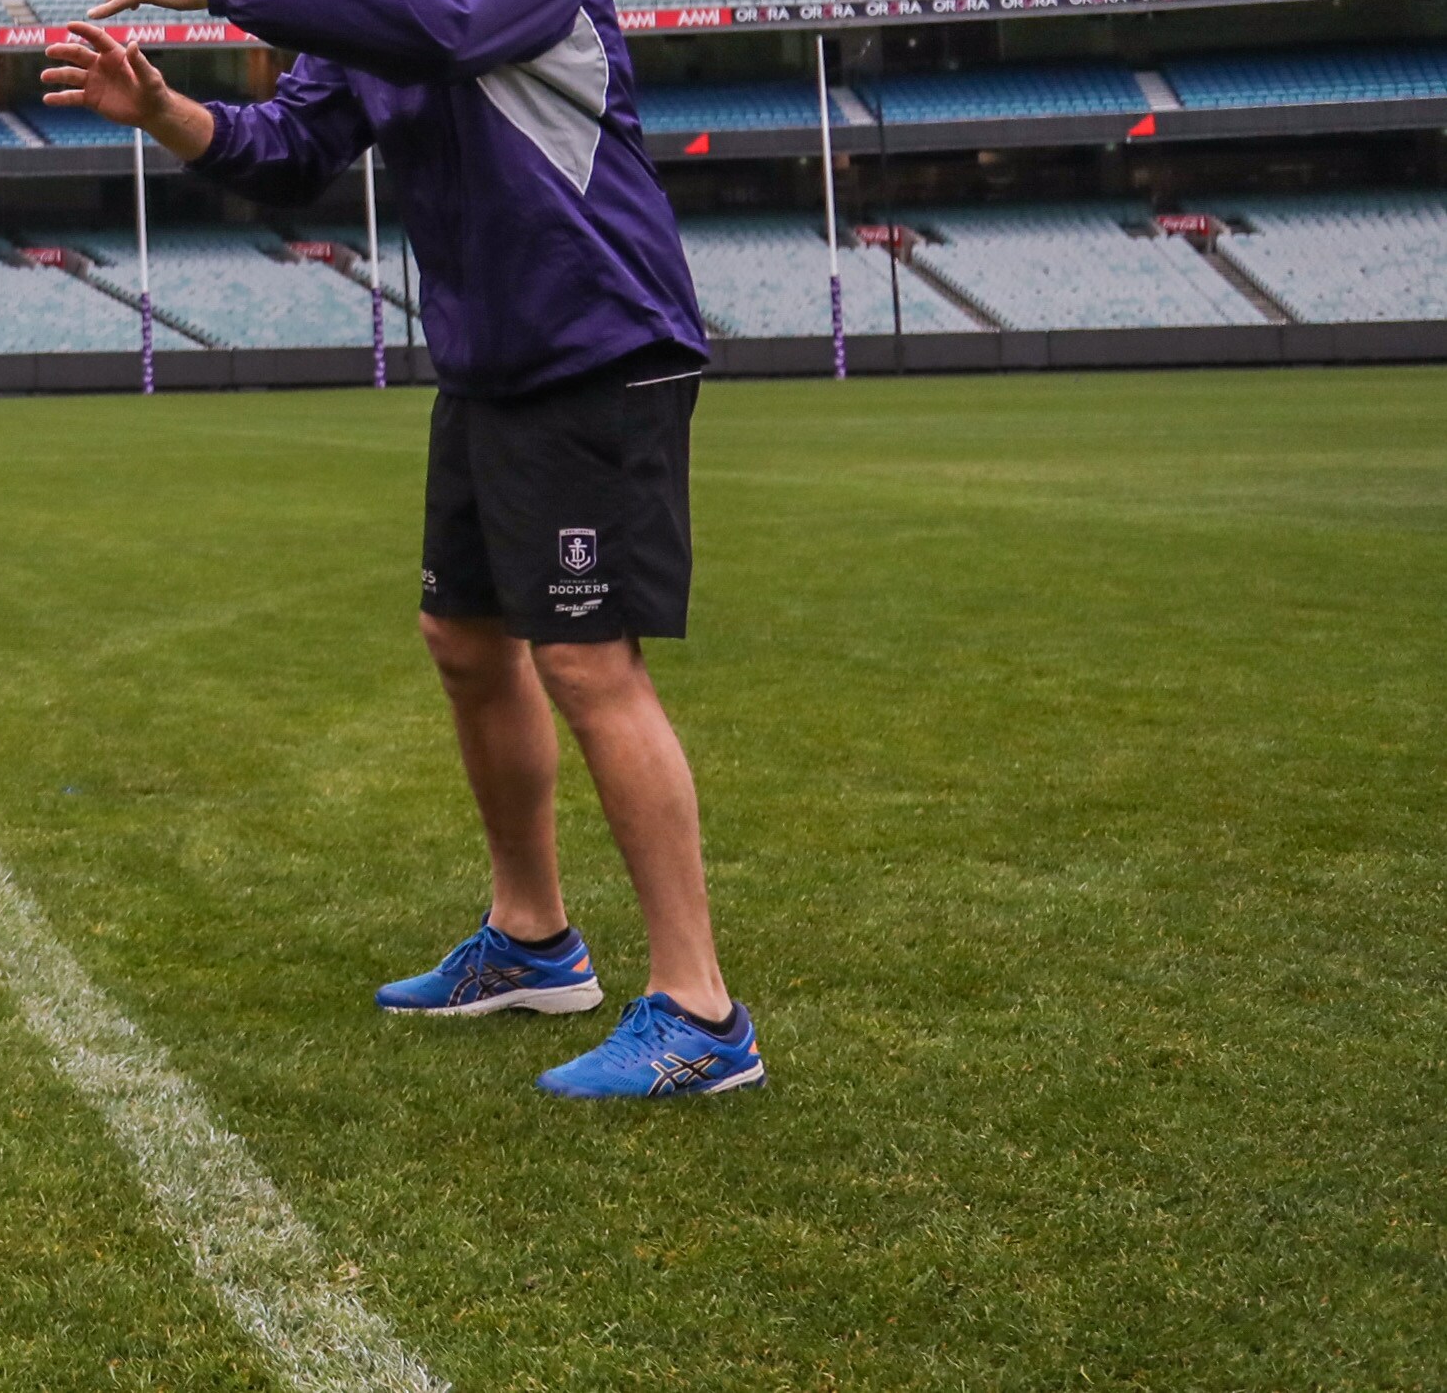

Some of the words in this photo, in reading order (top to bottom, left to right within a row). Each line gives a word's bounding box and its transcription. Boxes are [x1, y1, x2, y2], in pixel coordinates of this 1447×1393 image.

[735, 6, 790, 23] ORORA
[800, 3, 855, 19] ORORA
[866, 0, 922, 17] ORORA
[7, 28, 46, 44] AAMI
[126, 26, 166, 42] AAMI
[186, 25, 225, 41] AAMI
[678, 8, 720, 26] AAMI
[548, 583, 609, 596] DOCKERS
